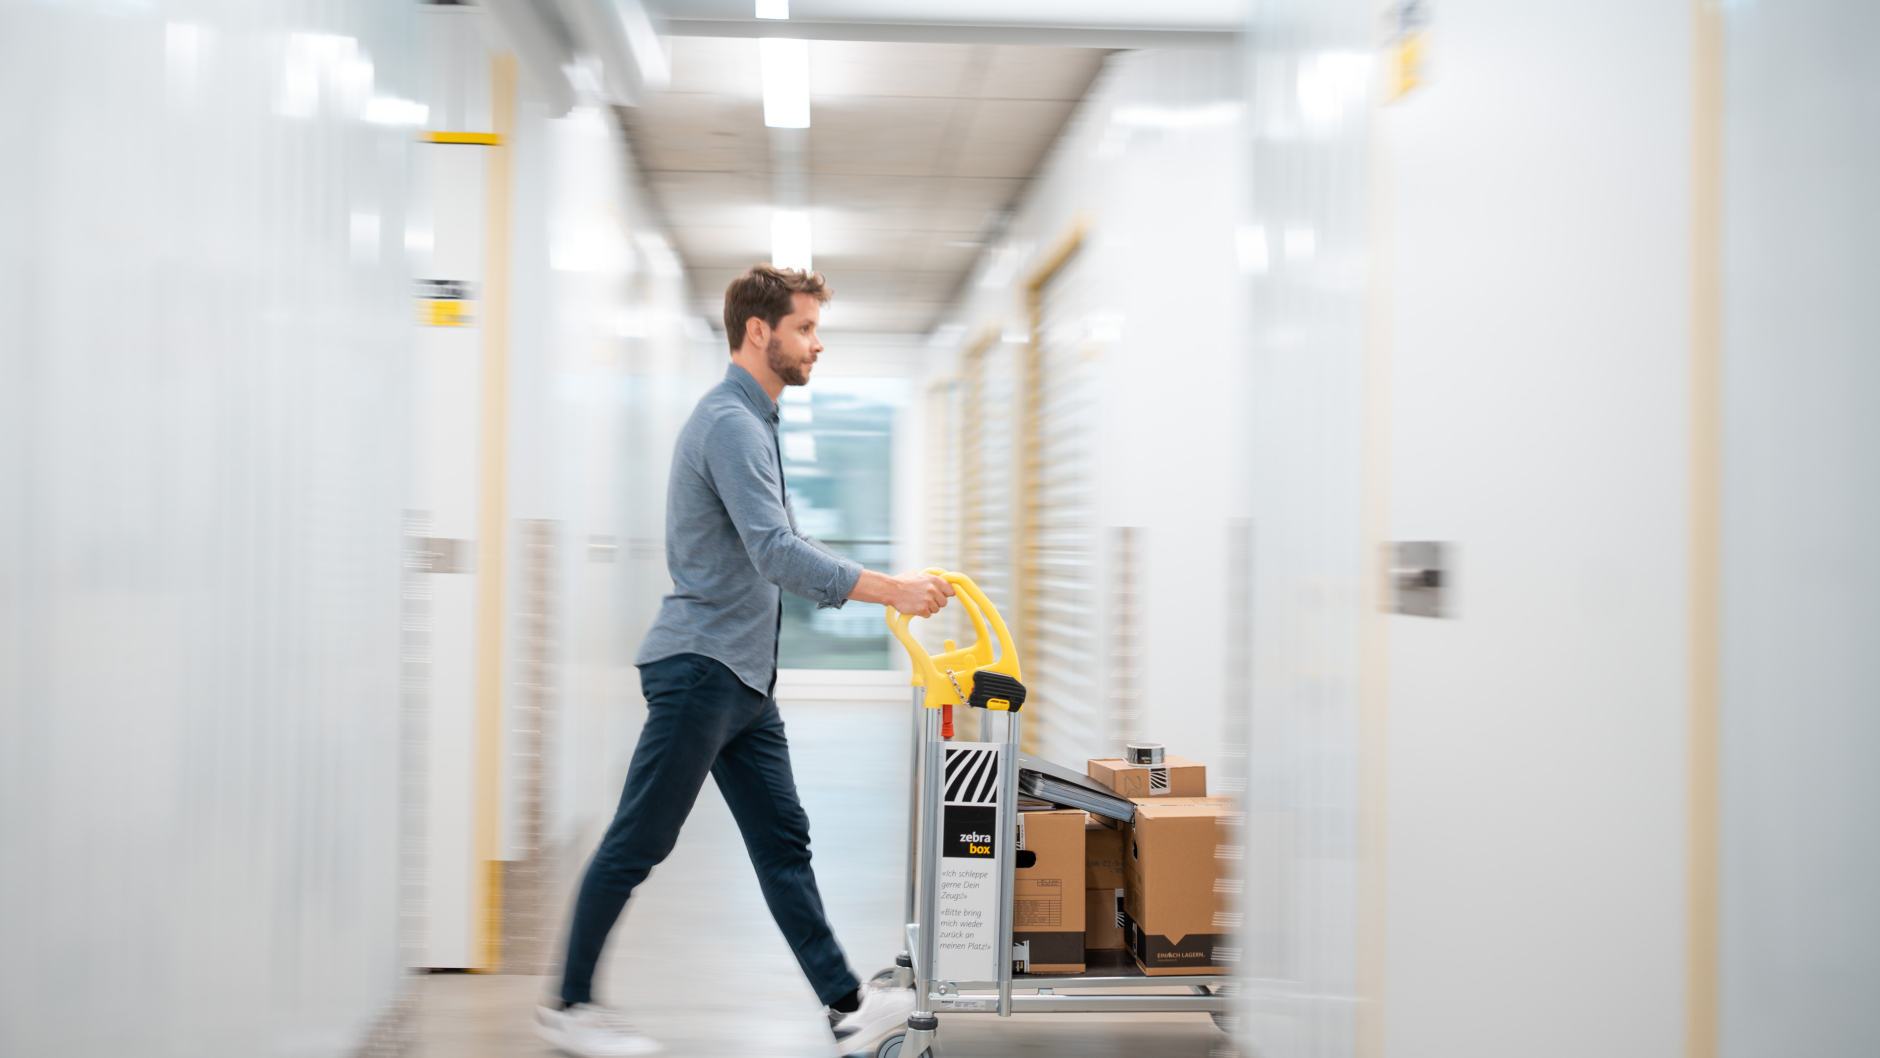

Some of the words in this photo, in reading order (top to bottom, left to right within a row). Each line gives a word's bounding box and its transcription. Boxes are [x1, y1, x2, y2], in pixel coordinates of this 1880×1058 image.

[959, 831, 991, 843] zebra
[969, 843, 991, 855] box
[958, 870, 988, 879] schleppe
[941, 882, 961, 890] gerne
[963, 881, 980, 889] Dein
[940, 908, 962, 916] «Bitte
[963, 909, 982, 918] bring
[960, 920, 983, 928] wieder
